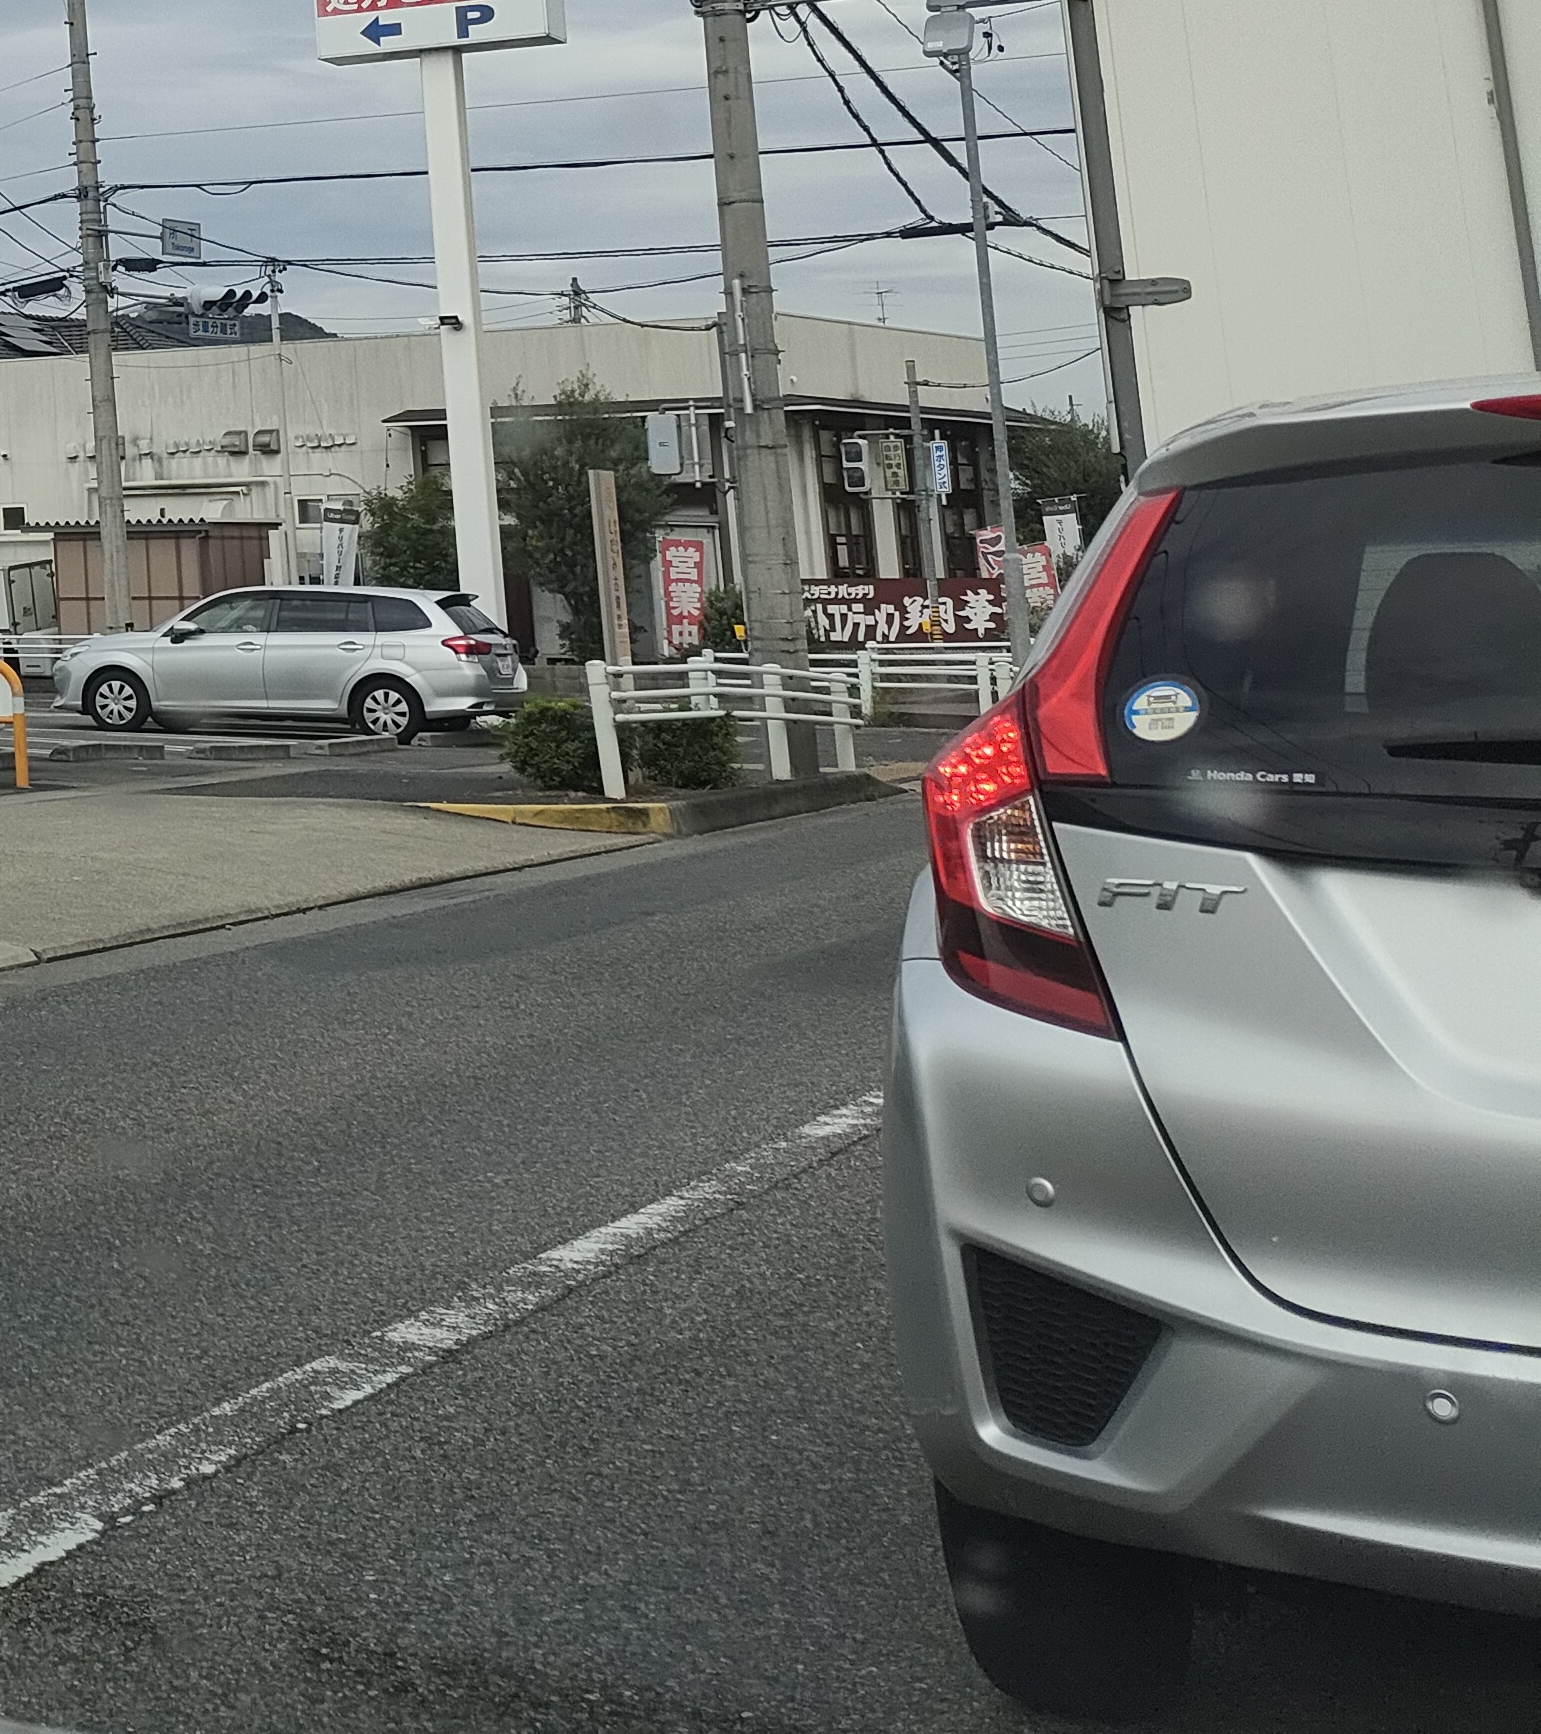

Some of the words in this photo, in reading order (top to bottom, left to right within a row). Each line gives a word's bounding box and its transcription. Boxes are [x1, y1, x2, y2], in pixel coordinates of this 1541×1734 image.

[456, 4, 495, 40] P
[934, 445, 948, 490] 押ボタン式
[665, 546, 702, 648] 営業中
[1206, 770, 1253, 781] Honda
[1256, 771, 1289, 782] Cars
[1097, 877, 1248, 915] FIT
